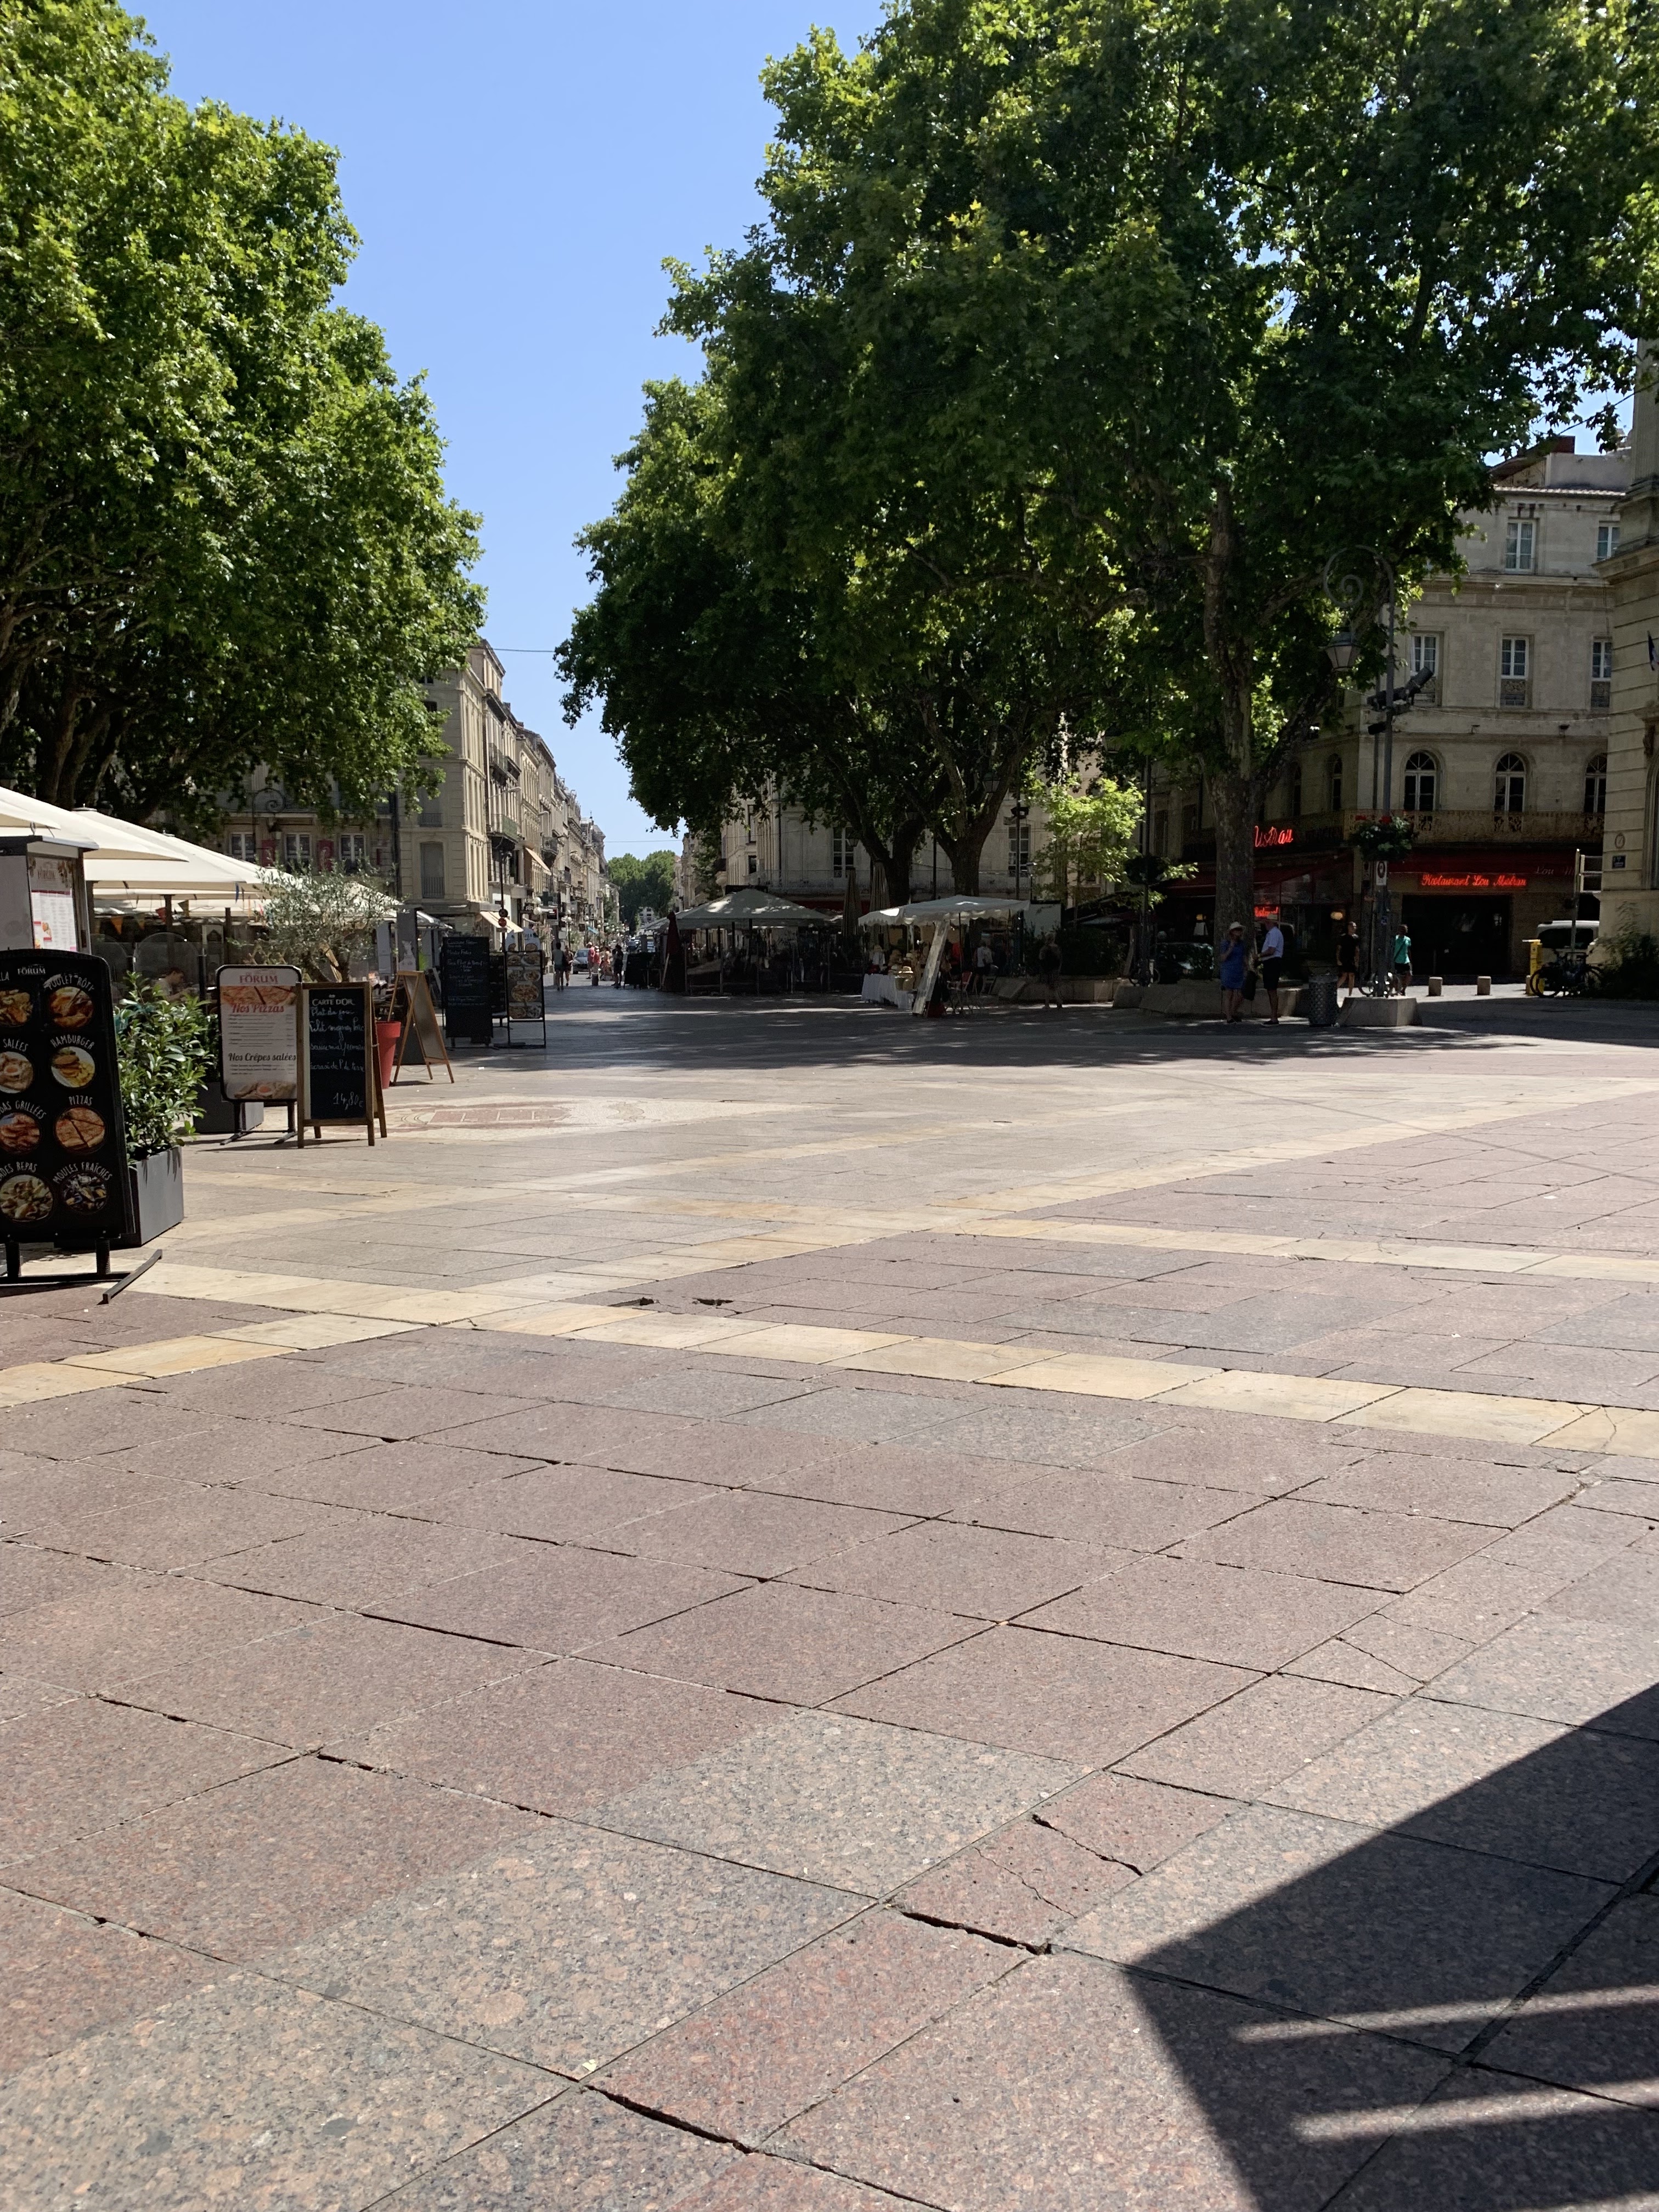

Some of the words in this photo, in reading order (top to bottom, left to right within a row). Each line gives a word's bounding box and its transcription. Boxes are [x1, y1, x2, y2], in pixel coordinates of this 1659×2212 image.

[1421, 874, 1469, 886] Restaurant
[1472, 874, 1489, 886] Lou
[0, 971, 9, 981] LA
[232, 1003, 250, 1013] Nos
[253, 1003, 284, 1013] Pizzas
[50, 1034, 95, 1049] HAMBURGER
[228, 1052, 243, 1061] Nos
[245, 1052, 270, 1063] Crêpes
[272, 1052, 296, 1061] salées
[68, 1095, 93, 1106] PIZZAS
[0, 1101, 12, 1114] BAS
[16, 1161, 37, 1173] REPAS
[53, 1163, 78, 1183] MOULES
